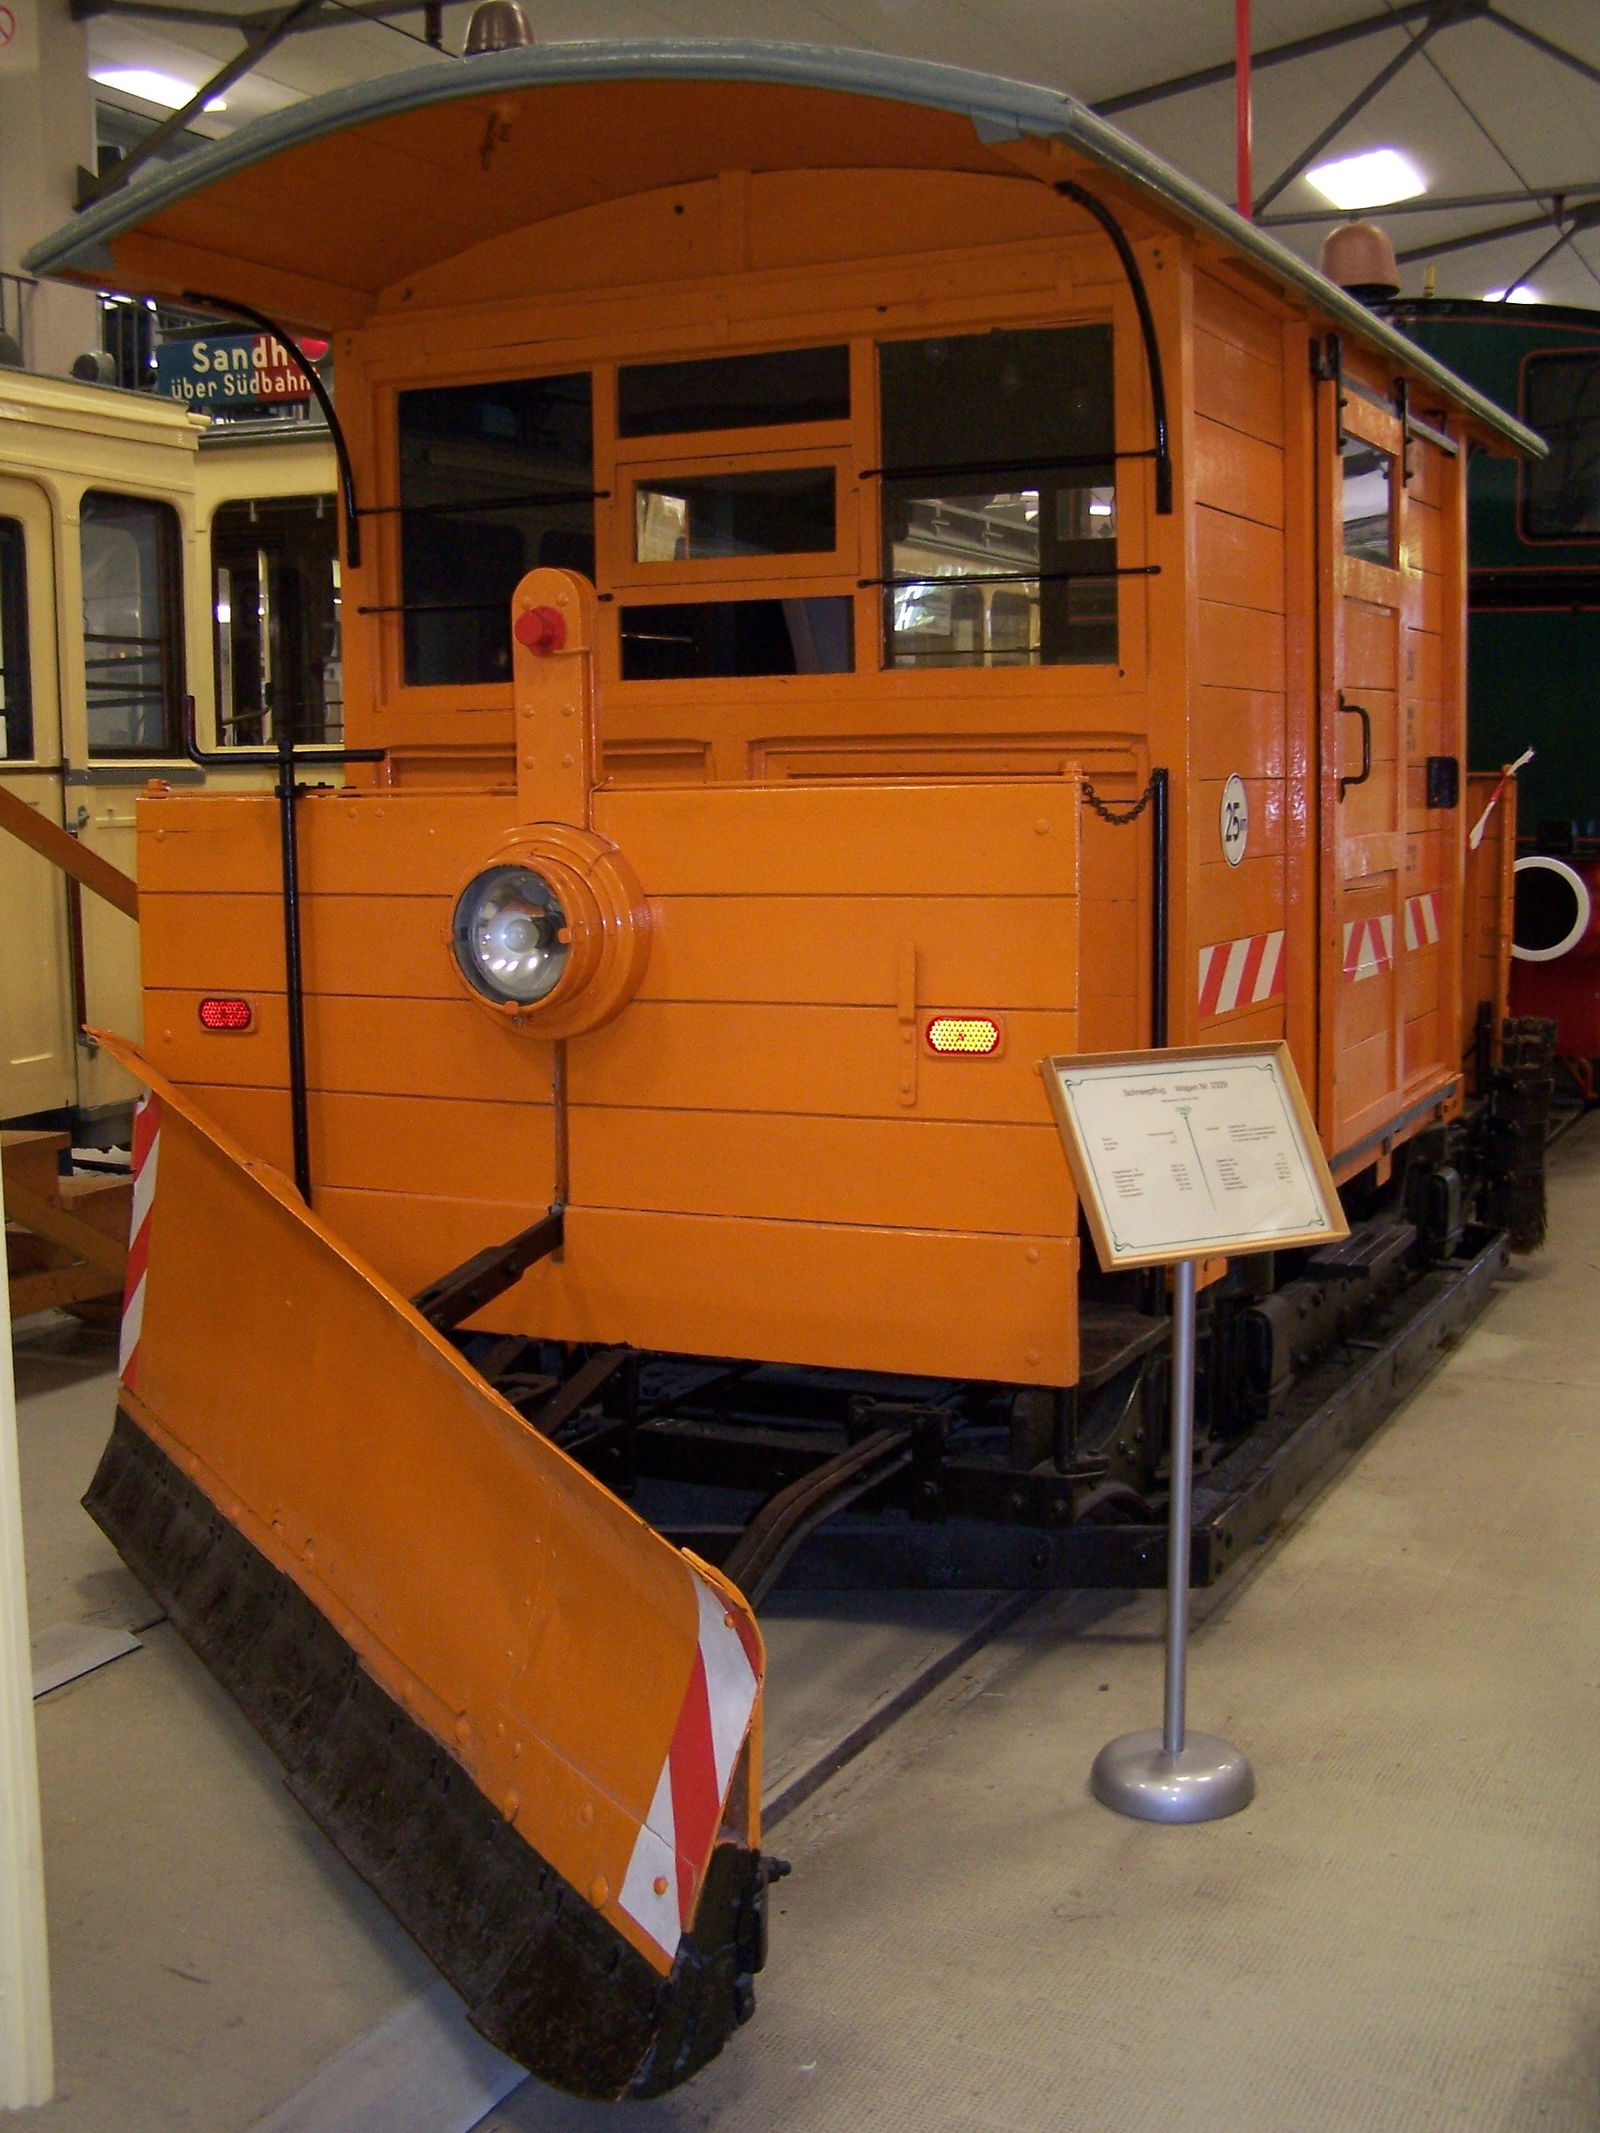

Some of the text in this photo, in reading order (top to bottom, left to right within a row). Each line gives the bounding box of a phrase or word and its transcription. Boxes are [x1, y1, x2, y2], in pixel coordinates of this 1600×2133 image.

[191, 335, 297, 373] Sandh
[171, 367, 319, 400] über Südbahn
